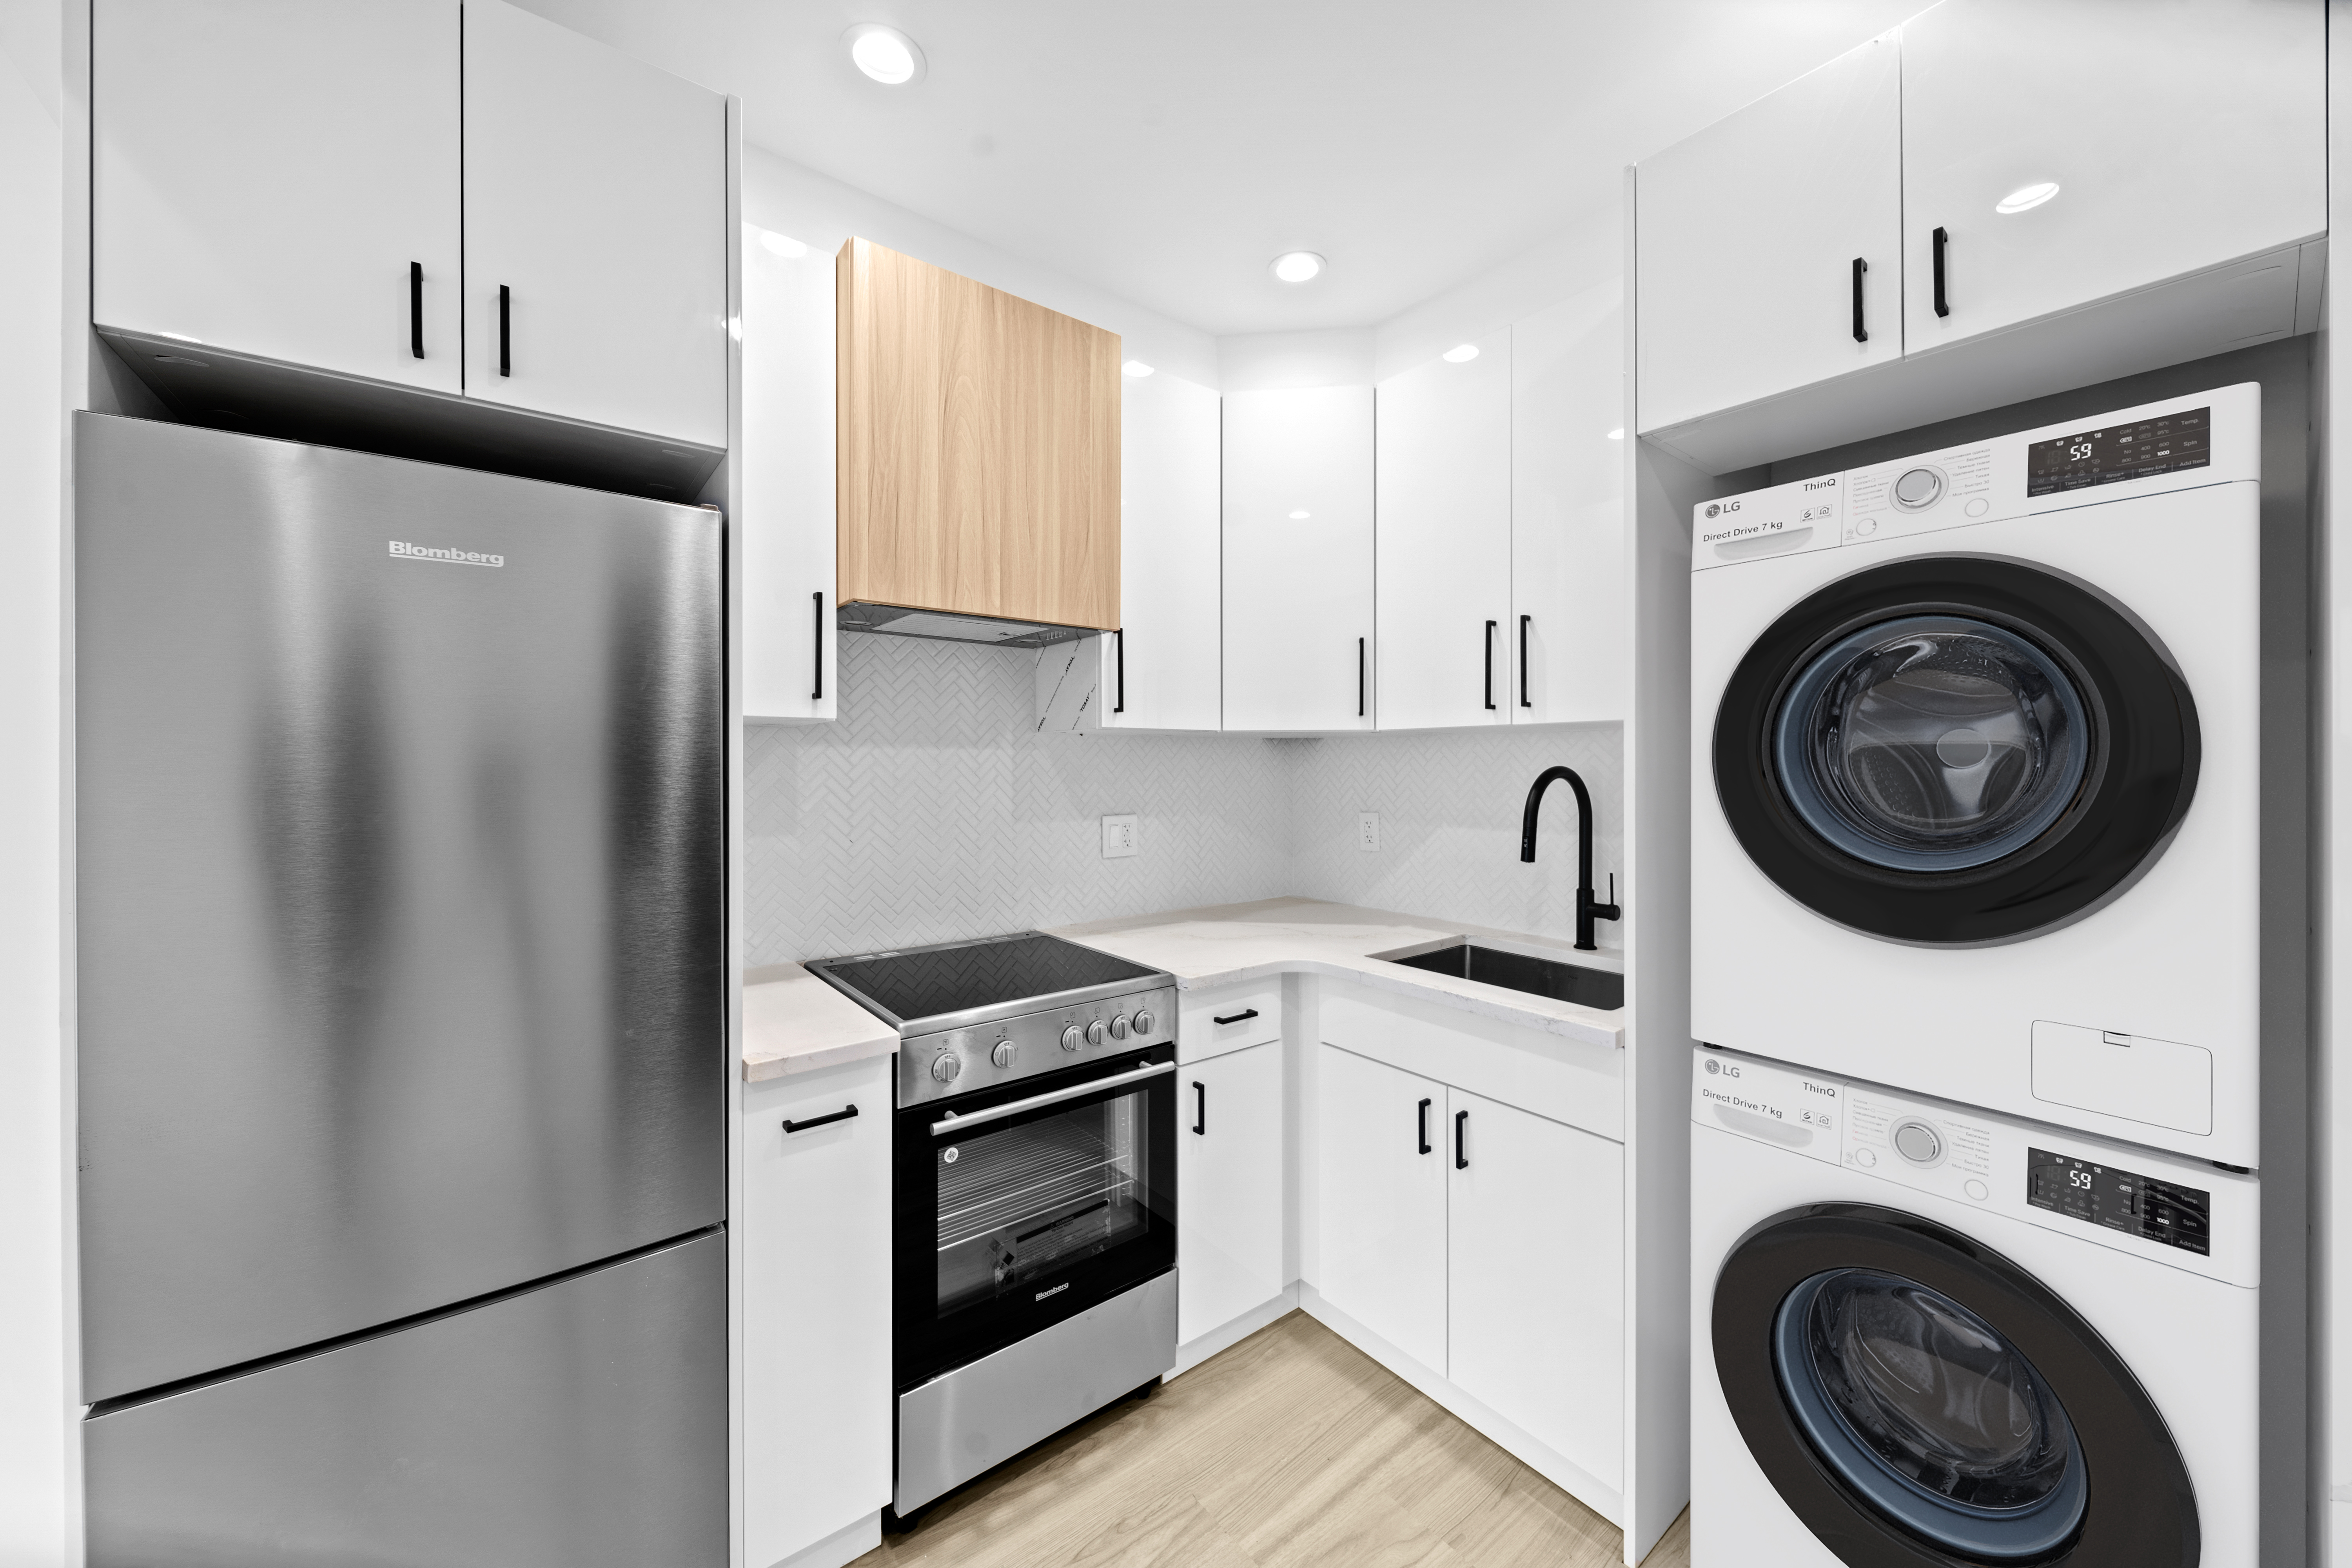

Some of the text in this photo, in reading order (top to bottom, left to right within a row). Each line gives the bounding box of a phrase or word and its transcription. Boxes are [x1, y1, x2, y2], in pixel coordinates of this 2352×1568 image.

[2070, 443, 2092, 461] 59
[1803, 478, 1836, 492] ThinQ
[1723, 501, 1740, 514] LG
[1703, 529, 1731, 542] Direct
[1733, 526, 1759, 536] Drive
[1770, 521, 1783, 530] kg
[389, 541, 504, 567] Blomberg
[1065, 656, 1075, 675] TORAY
[1079, 692, 1089, 712] TORAY
[1723, 1065, 1740, 1078] LG
[1803, 1082, 1835, 1098] ThinQ
[1703, 1089, 1730, 1103] Direct
[1733, 1097, 1758, 1111] Drive
[1770, 1107, 1782, 1119] kg
[2070, 1170, 2091, 1189] 59
[2031, 1196, 2054, 1206] Intensive
[2181, 1195, 2199, 1204] Temp.
[1055, 1216, 1074, 1226] WARNING
[2183, 1219, 2197, 1227] Spin
[2138, 1226, 2154, 1235] Delay
[1036, 1282, 1069, 1301] Blomberg
